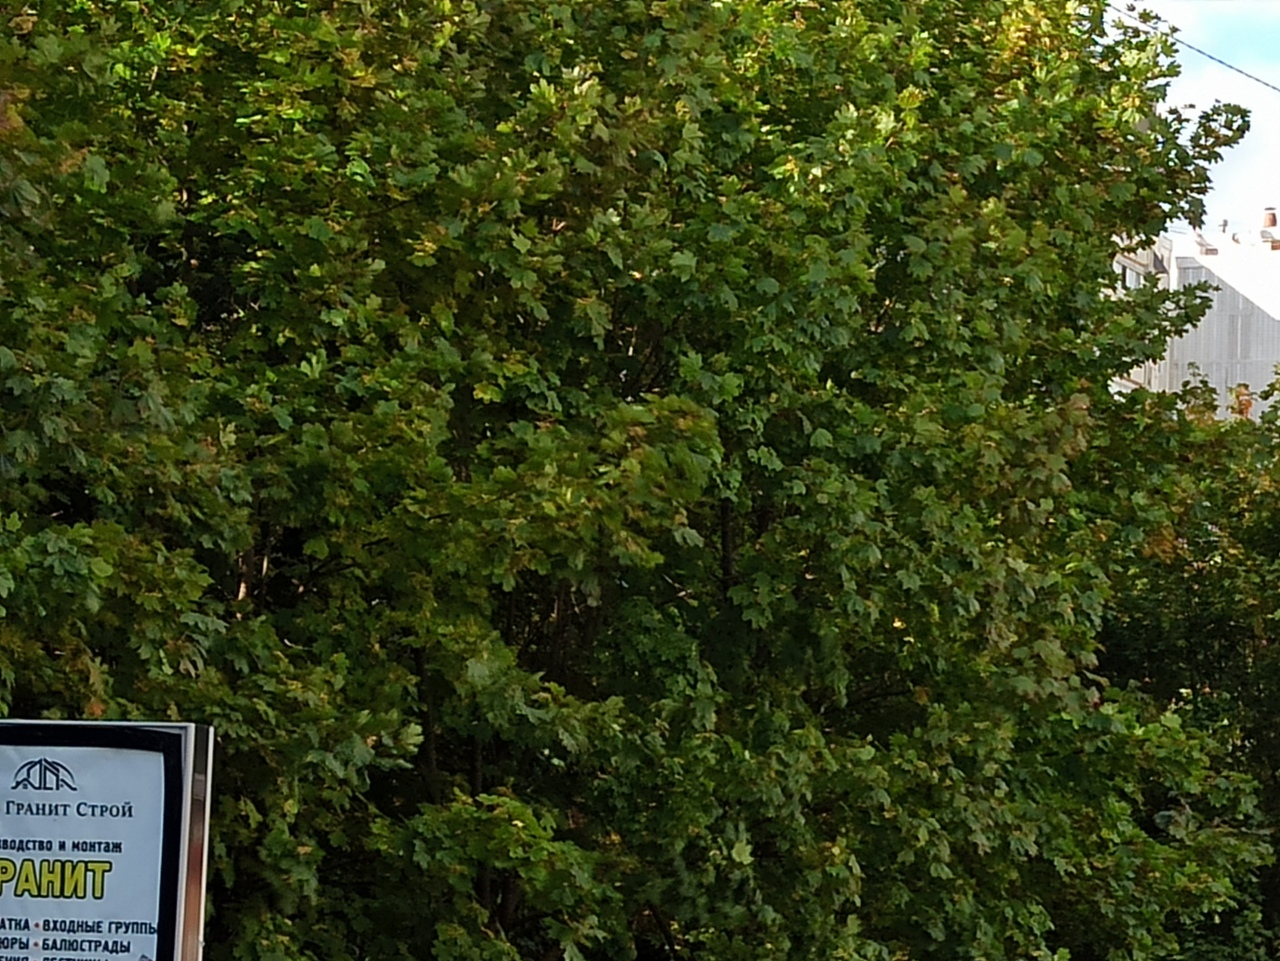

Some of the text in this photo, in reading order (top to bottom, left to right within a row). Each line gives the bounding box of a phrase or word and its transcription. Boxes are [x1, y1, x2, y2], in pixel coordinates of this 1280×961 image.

[0, 839, 53, 853] водство
[0, 858, 112, 899] РАНИТ
[42, 919, 103, 934] ВХОДНЫЕ
[42, 938, 131, 954] БАЛЮСТРАДЫ
